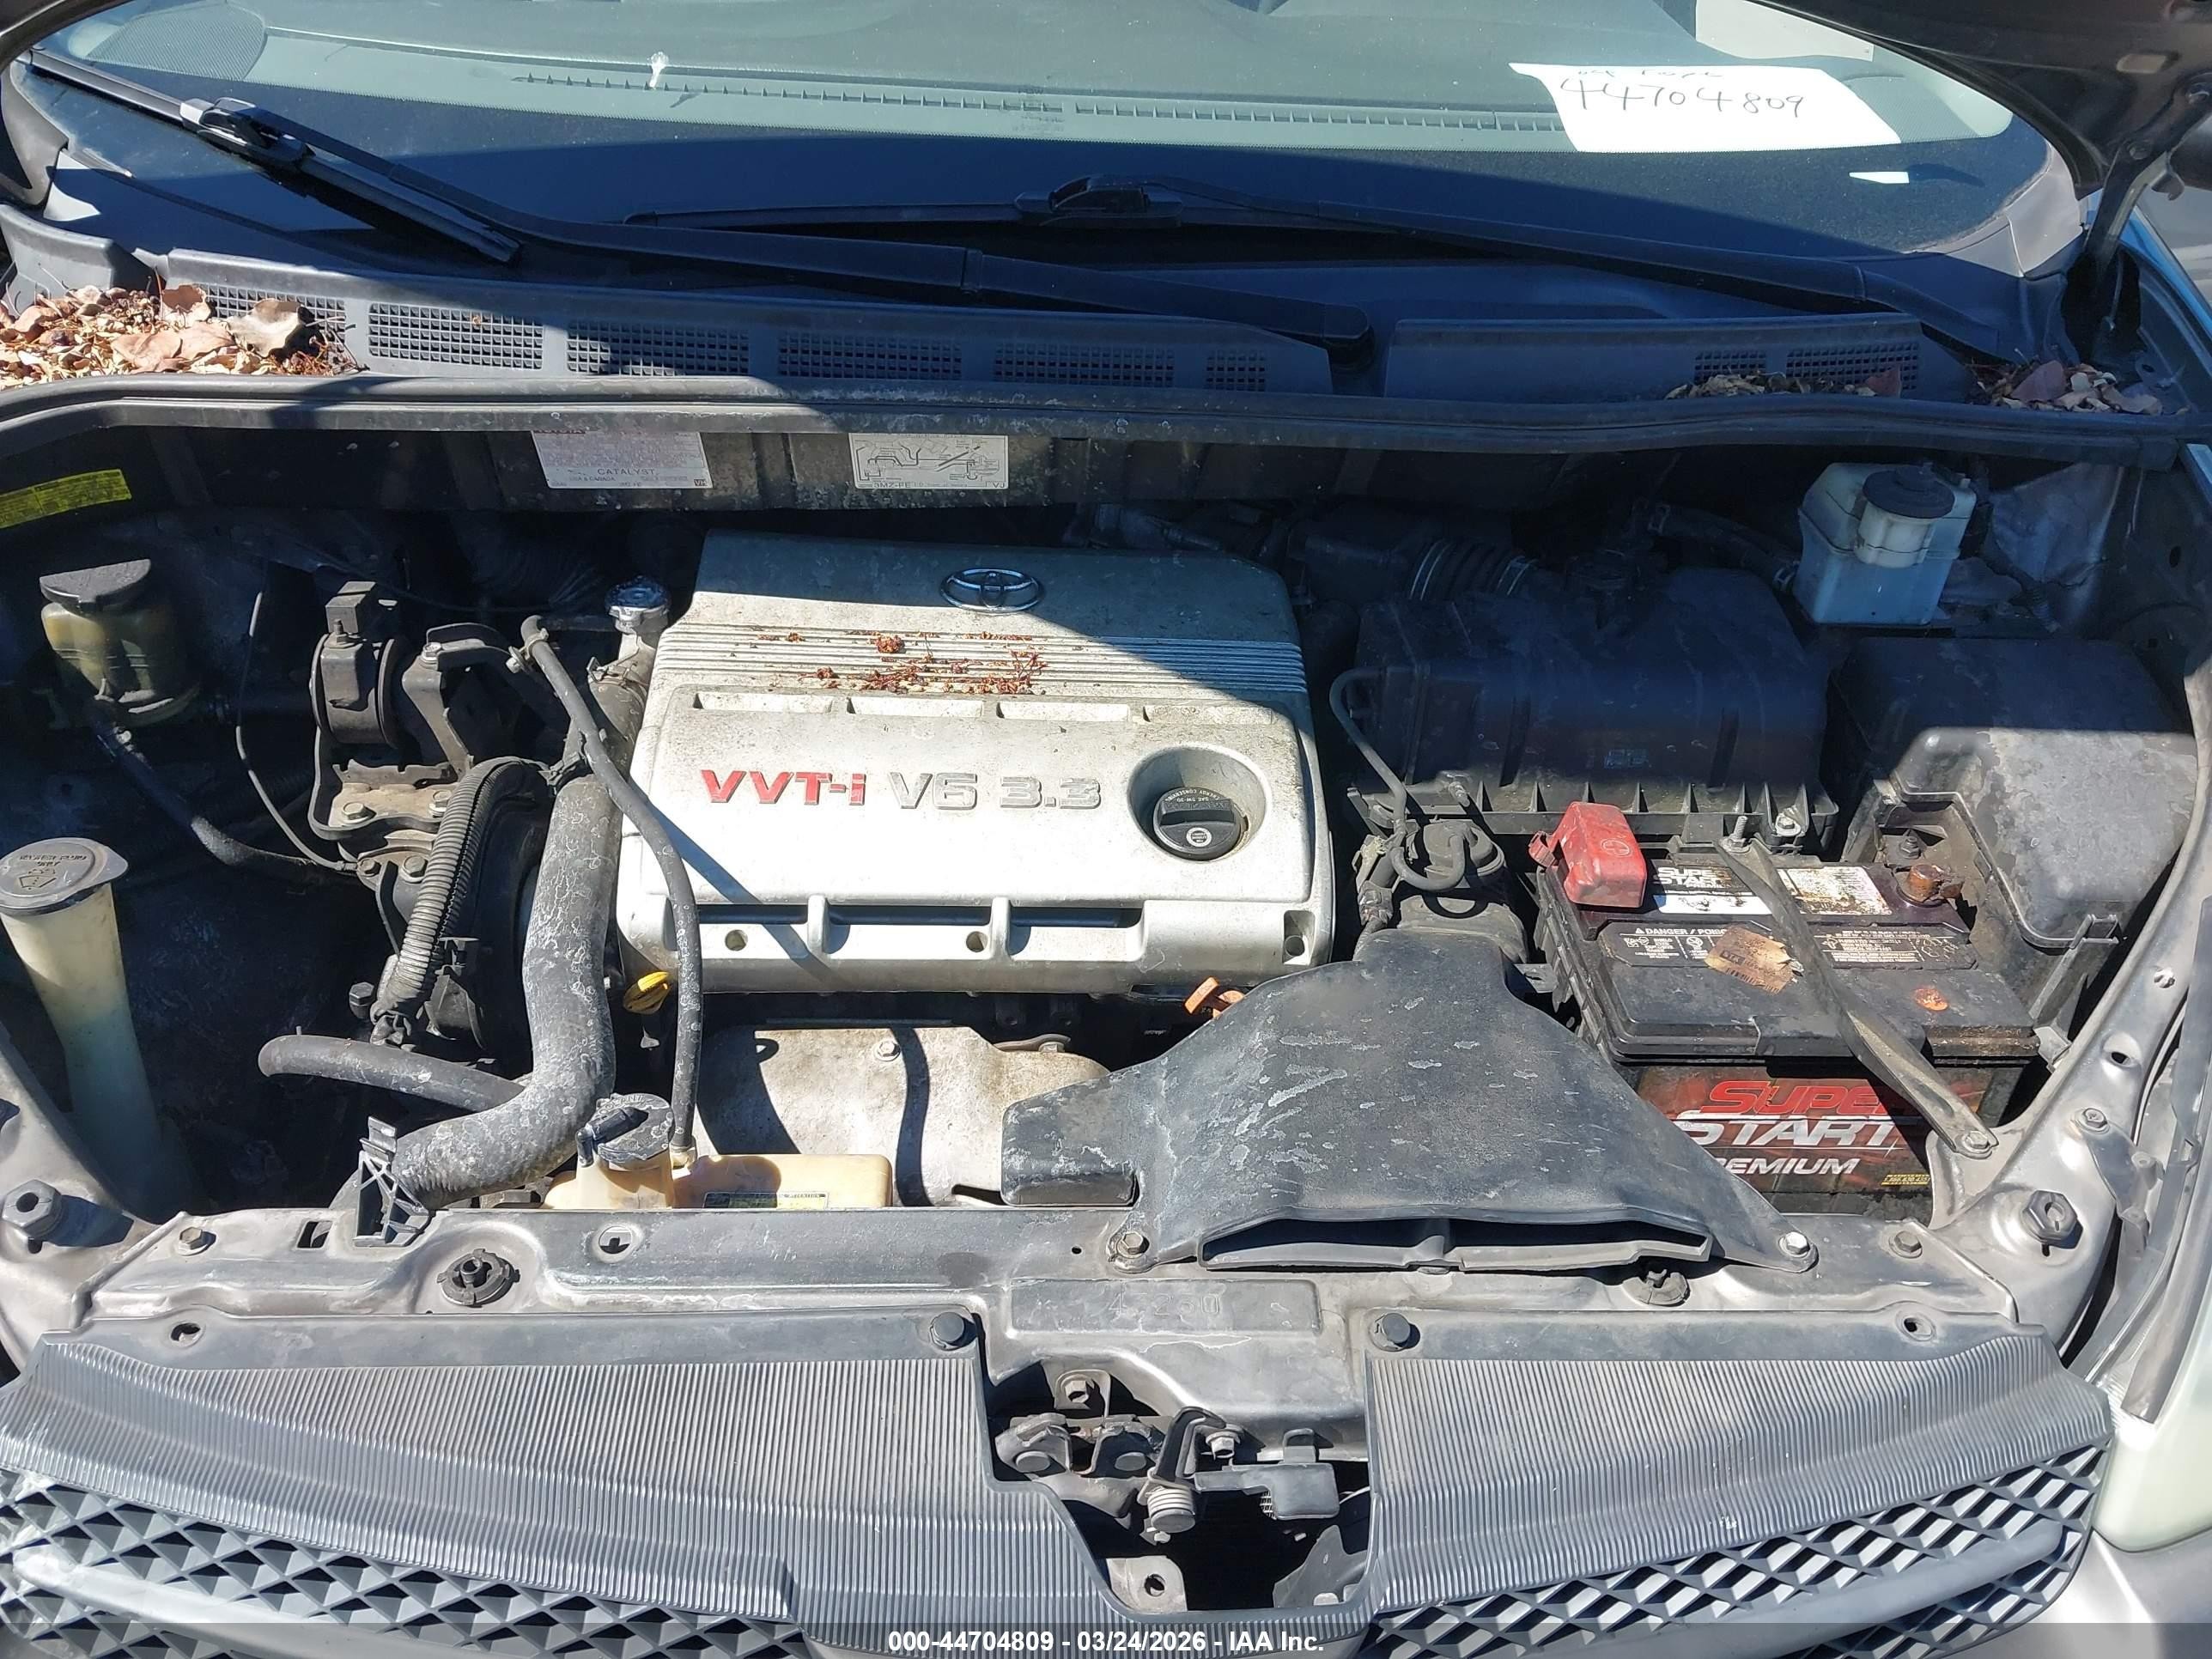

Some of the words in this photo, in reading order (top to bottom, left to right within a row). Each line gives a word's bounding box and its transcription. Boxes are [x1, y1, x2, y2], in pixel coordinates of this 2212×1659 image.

[1560, 78, 1803, 118] 44704809
[701, 769, 866, 805] VVT-i
[889, 772, 977, 810] V6
[1000, 775, 1102, 810] 3.3
[1674, 1109, 1895, 1146] START
